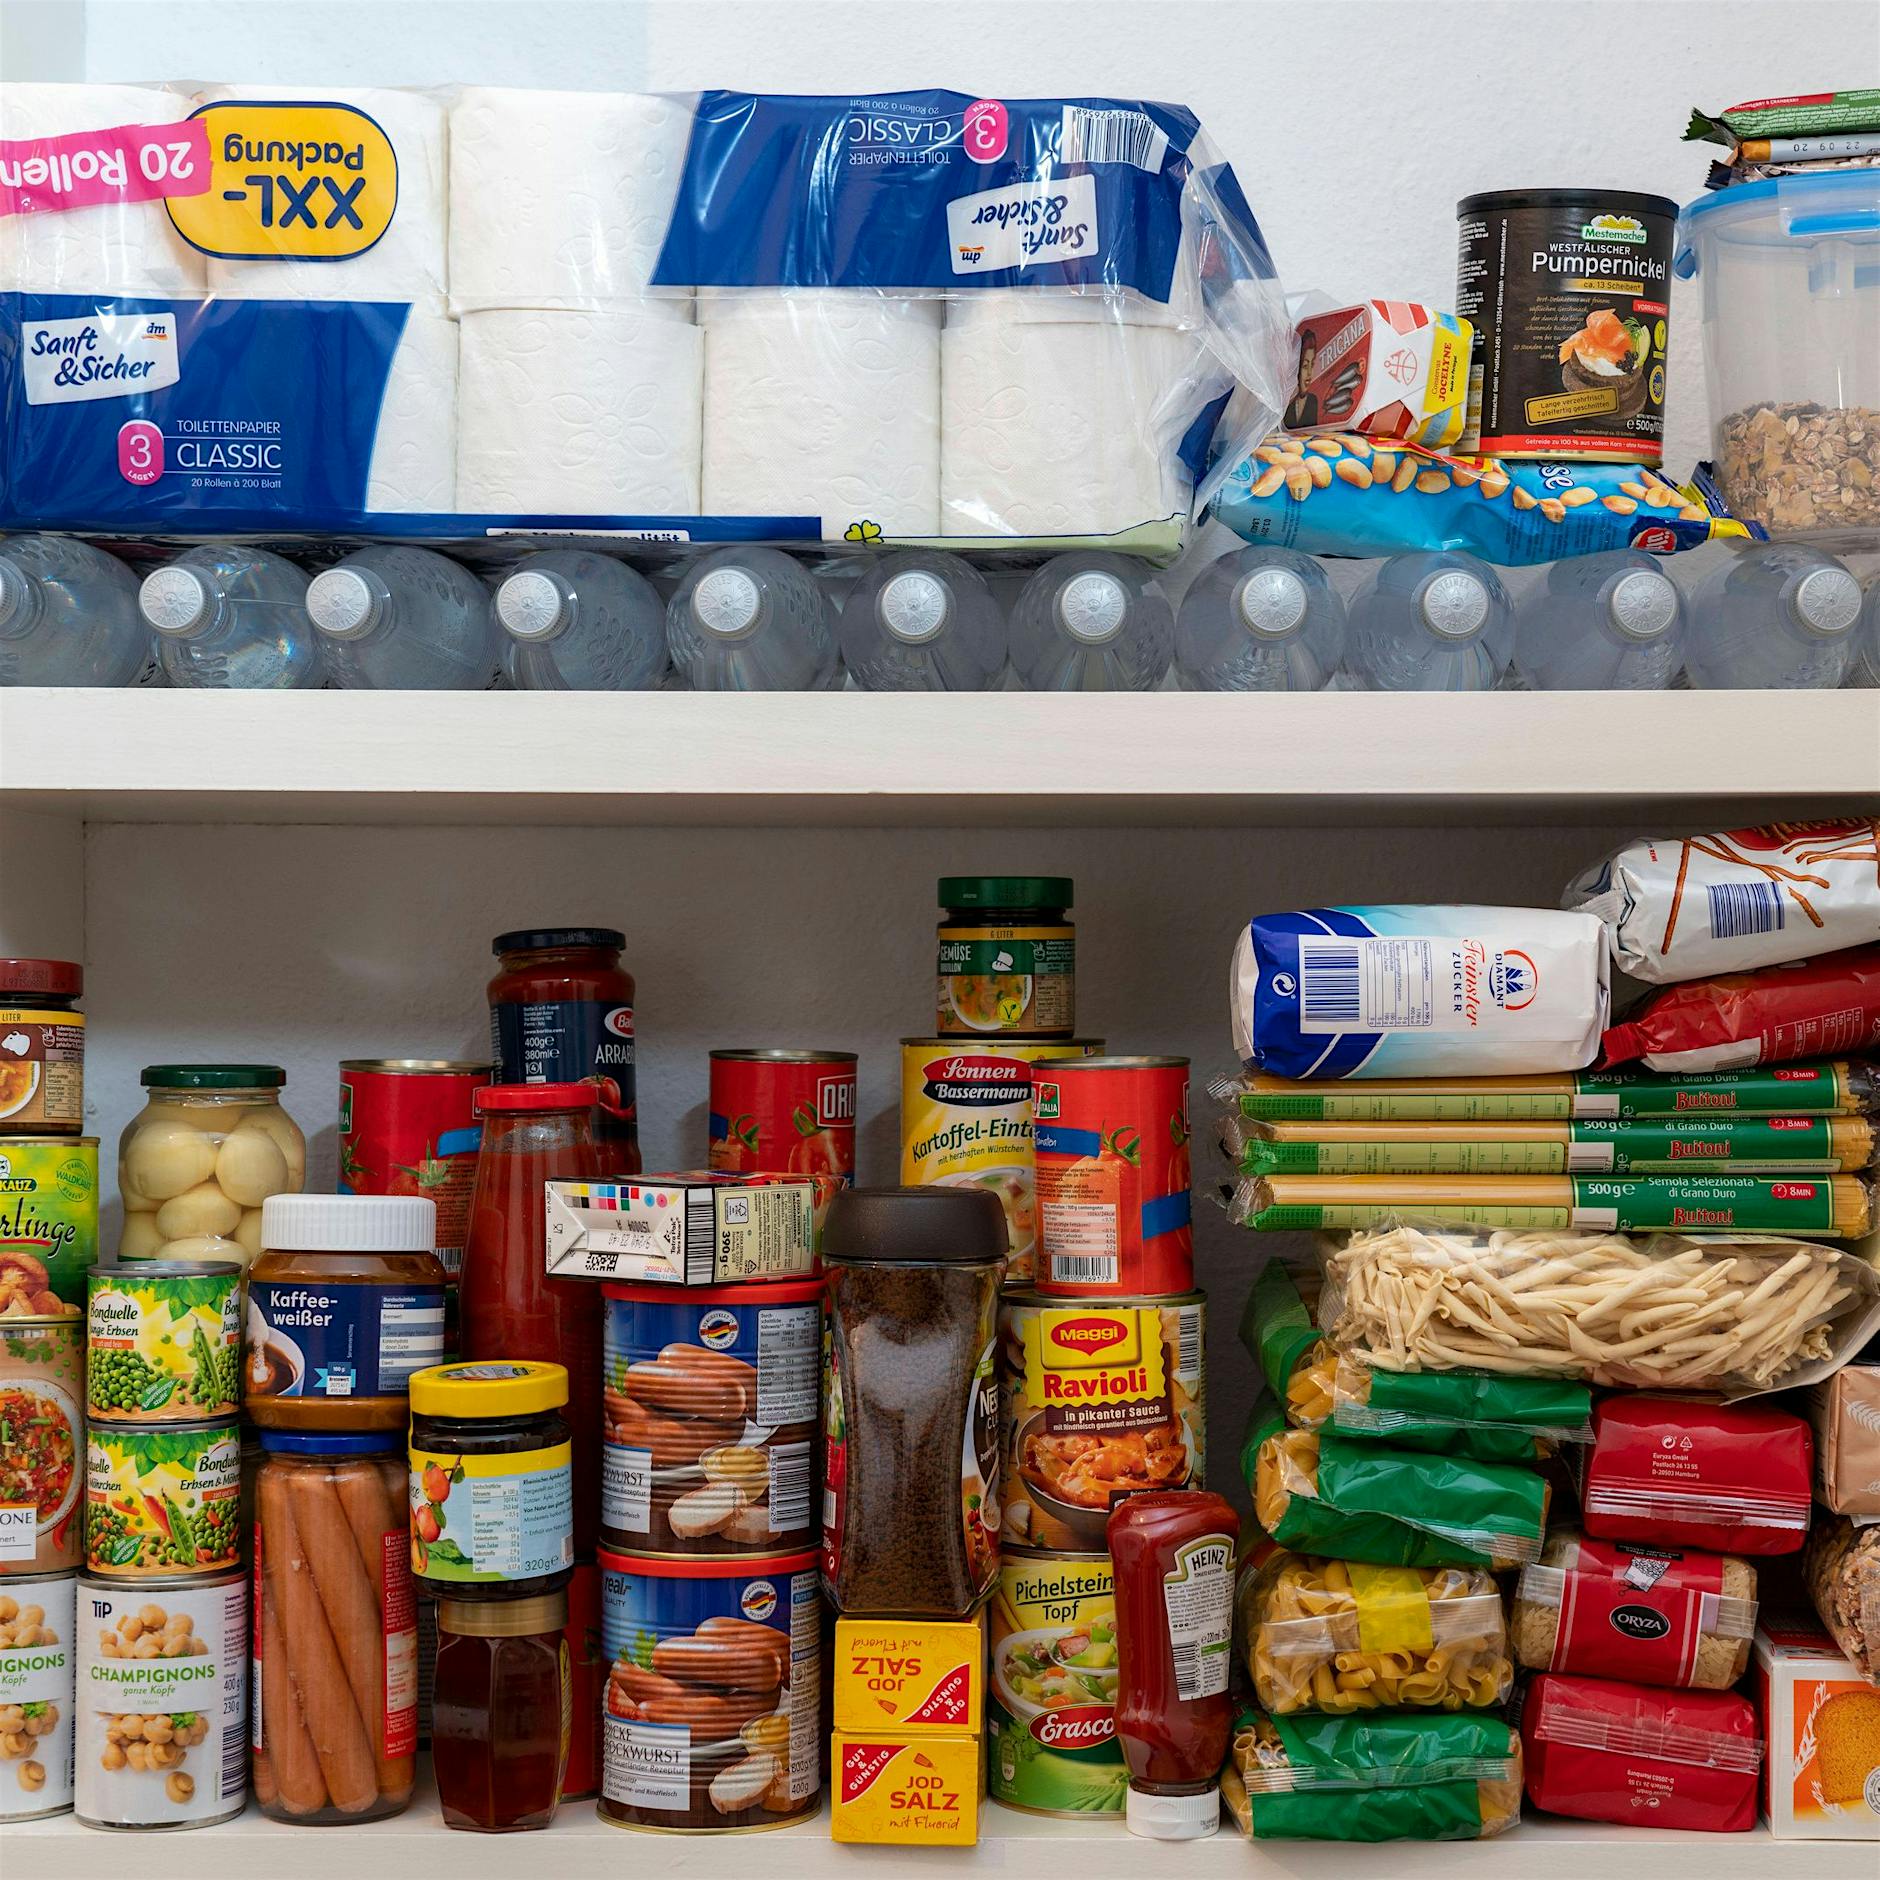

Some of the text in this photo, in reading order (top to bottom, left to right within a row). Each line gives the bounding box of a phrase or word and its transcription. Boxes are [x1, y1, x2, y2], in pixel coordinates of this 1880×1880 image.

[850, 99, 939, 114] 20 Rollen 200 Blatt
[850, 118, 951, 144] CLASSIC
[975, 115, 996, 149] 3
[224, 133, 364, 171] Packung
[1793, 143, 1808, 152] 20
[140, 142, 193, 181] 20
[850, 152, 951, 165] TOILETTENPAPIER
[223, 175, 366, 230] XXL-
[1023, 222, 1089, 256] Sanft
[1585, 227, 1645, 242] Mestemacher
[1550, 242, 1631, 255] WESTFÄLISCHER
[1532, 252, 1666, 281] Pumpernickel
[1597, 281, 1605, 289] 13
[147, 322, 165, 336] dm
[31, 326, 98, 357] Sanft
[1319, 313, 1367, 370] TRICANA
[1493, 350, 1501, 373] Postfach
[1438, 342, 1452, 402] JOCELYNE
[1490, 389, 1498, 429] Mestemacher
[1537, 401, 1610, 418] Tafelfertig geschnitten
[1540, 394, 1605, 409] Lange verzehrfrisch
[177, 420, 282, 435] TOILETTENPAPIER
[129, 434, 151, 468] 3
[177, 443, 282, 469] CLASSIC
[128, 470, 155, 482] LAGEN
[191, 477, 282, 489] 20 Rollen à 200 Blatt
[996, 930, 1014, 938] LITER
[940, 942, 971, 961] GEMÜSE
[1452, 952, 1462, 1013] ZUCKER
[1463, 937, 1486, 1028] Feinster
[1495, 953, 1504, 1009] DIAMANT
[3, 1013, 21, 1022] LITER
[943, 1058, 1017, 1079] Sonnen
[1793, 1070, 1815, 1078] 8MIN
[1670, 1074, 1738, 1083] di Grano Duro
[934, 1083, 1028, 1100] Bassermann
[1675, 1091, 1737, 1111] Buitoni
[1584, 1121, 1607, 1130] 500
[1665, 1122, 1733, 1131] di Grano Duro
[1787, 1119, 1809, 1128] 8MIN
[938, 1144, 1025, 1165] mit herzhaften Würstchen
[1670, 1139, 1730, 1159] Buitoni
[1588, 1184, 1612, 1195] 500
[1649, 1177, 1754, 1188] Semola Selezionata
[1668, 1188, 1736, 1198] di Grano Duro
[1789, 1187, 1812, 1198] 8MIN
[1672, 1208, 1734, 1228] Buitoni
[270, 1290, 338, 1308] Kaffee-
[273, 1310, 333, 1327] weißer
[107, 1324, 139, 1337] Erbsen
[1060, 1326, 1119, 1341] Maggi
[1043, 1367, 1147, 1398] Ravioli
[1065, 1404, 1160, 1424] in pikanter Sauce
[1063, 1421, 1096, 1431] Rindfleisch
[1096, 1420, 1125, 1431] garantiert
[1125, 1419, 1136, 1427] aus
[1136, 1415, 1168, 1426] Deutschland
[1675, 1471, 1700, 1479] Hamburg
[180, 1479, 214, 1491] Erbsen
[1192, 1549, 1225, 1570] HEINZ
[1016, 1572, 1114, 1600] Pichelstein
[93, 1600, 112, 1619] TiP
[1042, 1601, 1081, 1622] Topf
[1617, 1613, 1662, 1631] ORYZA
[852, 1637, 922, 1652] mit Fluorid
[91, 1664, 216, 1683] CHAMPIGNONS
[852, 1657, 921, 1676] SALZ
[123, 1683, 176, 1697] ganze Köpfe
[867, 1679, 904, 1691] JOD
[922, 1676, 963, 1718] GÜNSTIG
[944, 1697, 954, 1707] &
[946, 1699, 966, 1720] GUT
[1040, 1712, 1115, 1743] Erasco
[845, 1748, 865, 1769] GUT
[858, 1761, 867, 1769] &
[650, 1764, 685, 1775] Rezeptur
[849, 1750, 890, 1791] GÜNSTIG
[907, 1776, 944, 1789] JOD
[634, 1787, 678, 1797] und Rindfleisch
[890, 1791, 959, 1811] SALZ
[890, 1815, 960, 1830] mit Fluorid
